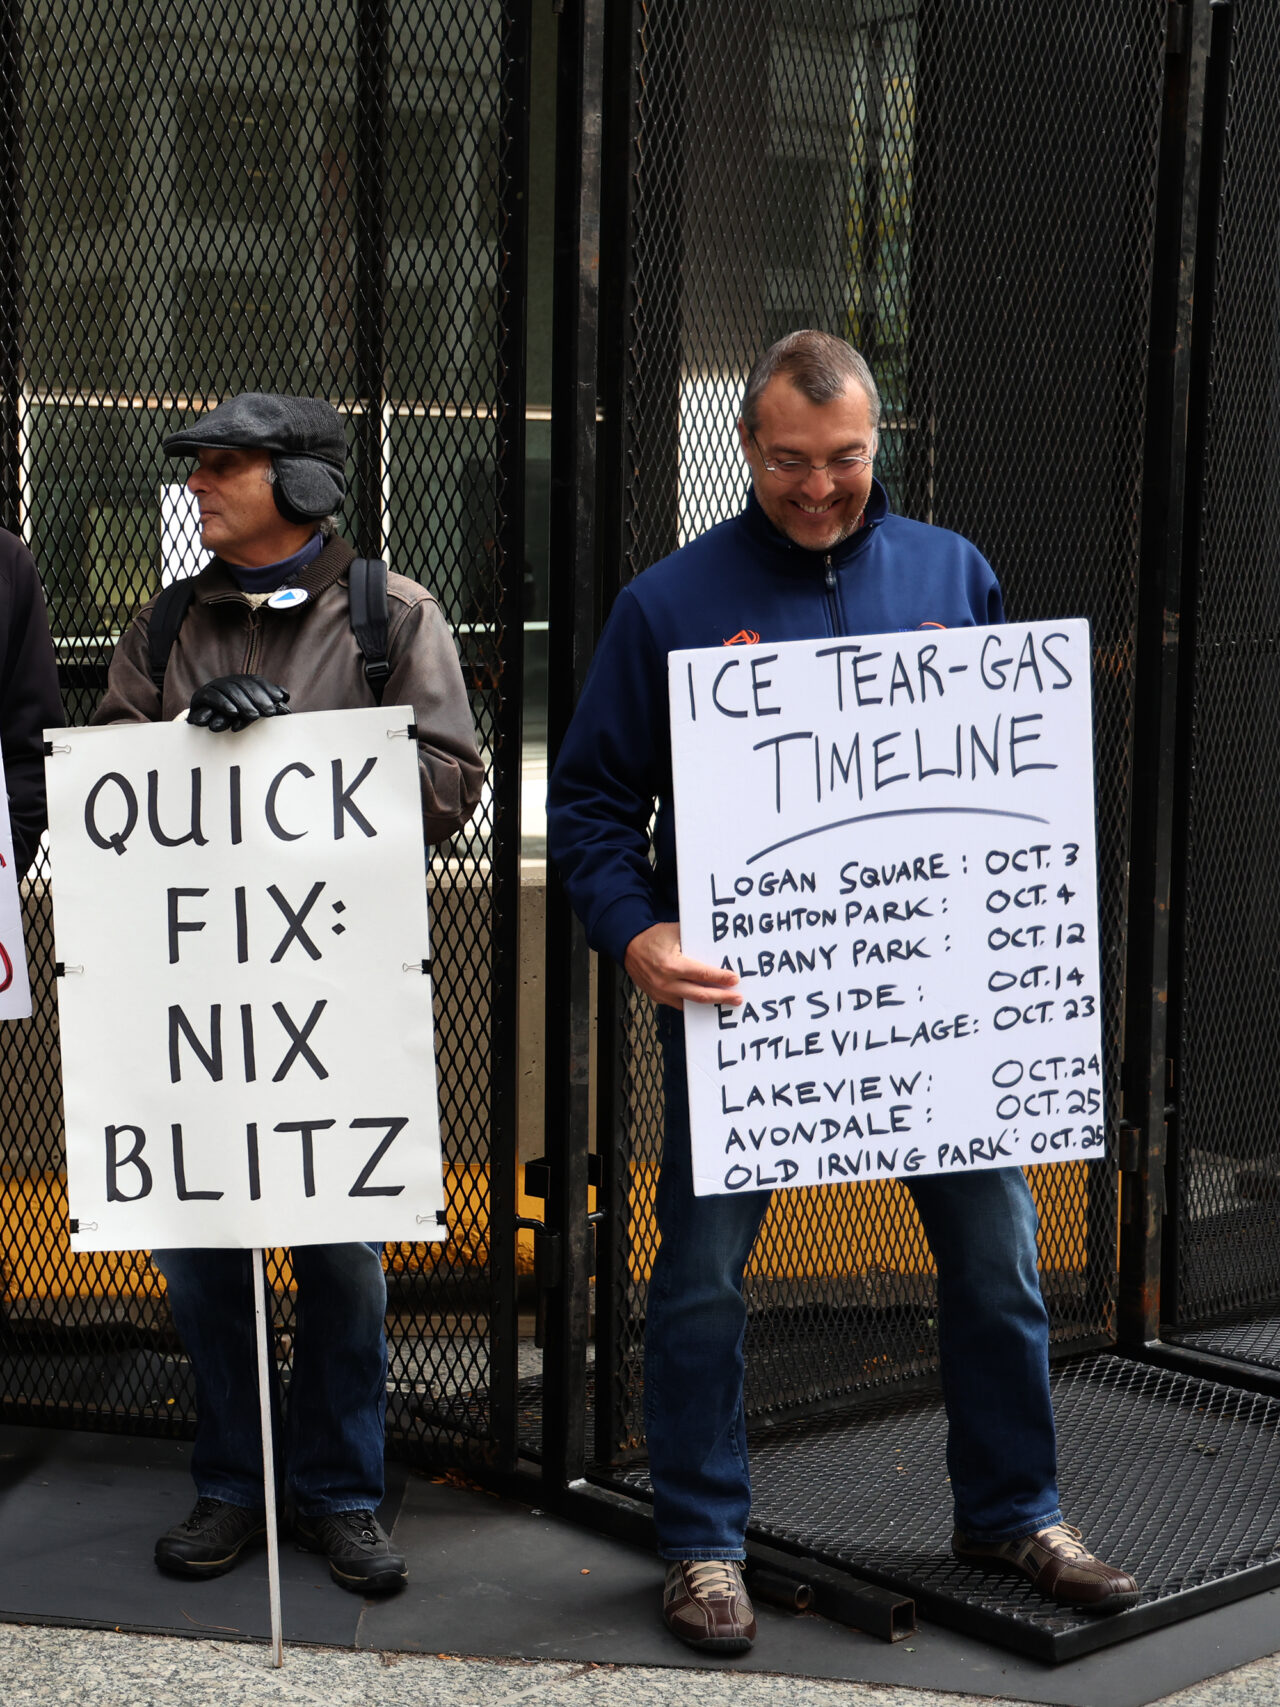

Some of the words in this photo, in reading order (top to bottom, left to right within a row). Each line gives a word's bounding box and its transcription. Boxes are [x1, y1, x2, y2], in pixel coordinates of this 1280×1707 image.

[687, 652, 782, 722] ICE
[815, 630, 1073, 712] TEAR-GAS
[752, 713, 1059, 814] TIMELINE
[83, 756, 379, 856] QUICK
[711, 868, 817, 907] LOGAN
[985, 844, 1052, 876] OCT.
[1062, 842, 1080, 867] 3
[166, 881, 347, 965] FIX:
[711, 907, 838, 943] BRIGHTON
[985, 884, 1048, 914] OCT.
[1056, 883, 1076, 906] 4
[720, 943, 838, 978] ALBANY
[987, 925, 1047, 952] OCT.
[1055, 923, 1086, 949] 12
[167, 999, 330, 1084] NIX
[714, 999, 796, 1030] EAST
[718, 1031, 825, 1071] LITTLE
[831, 1013, 980, 1056] VILLAGE:
[993, 1000, 1055, 1031] OCT.
[1063, 995, 1095, 1021] 23
[721, 1071, 933, 1114] LAKEVIEW:
[996, 1089, 1060, 1121] OCT.
[1066, 1087, 1101, 1117] 25
[104, 1117, 409, 1203] BLITZ
[724, 1158, 799, 1190] OLD
[818, 1147, 927, 1180] IRVING
[1031, 1127, 1077, 1154] OCT.
